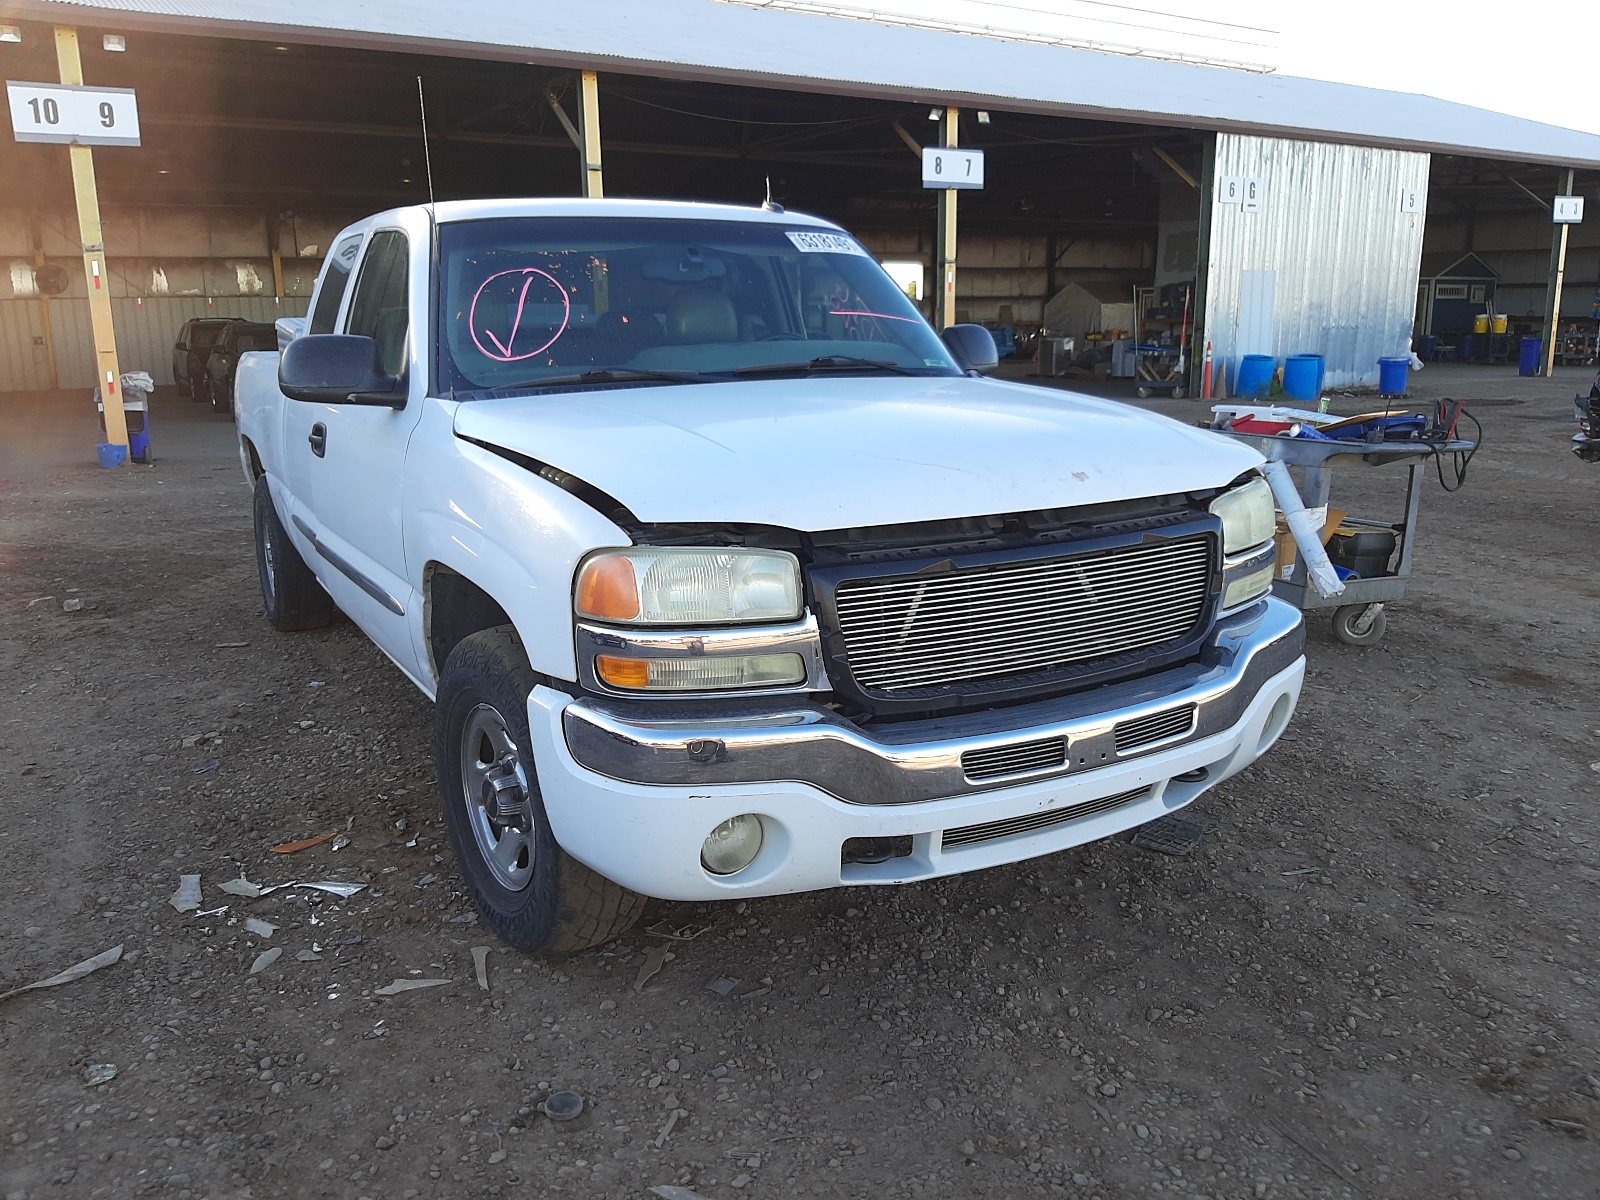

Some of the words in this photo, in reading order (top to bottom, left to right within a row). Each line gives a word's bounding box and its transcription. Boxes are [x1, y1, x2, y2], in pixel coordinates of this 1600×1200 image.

[28, 97, 60, 125] 10
[99, 102, 115, 128] 9
[935, 156, 942, 175] 8
[965, 158, 972, 177] 7
[1229, 181, 1236, 198] 6
[1249, 181, 1256, 200] G
[1409, 193, 1415, 208] 5
[1559, 202, 1564, 216] 4
